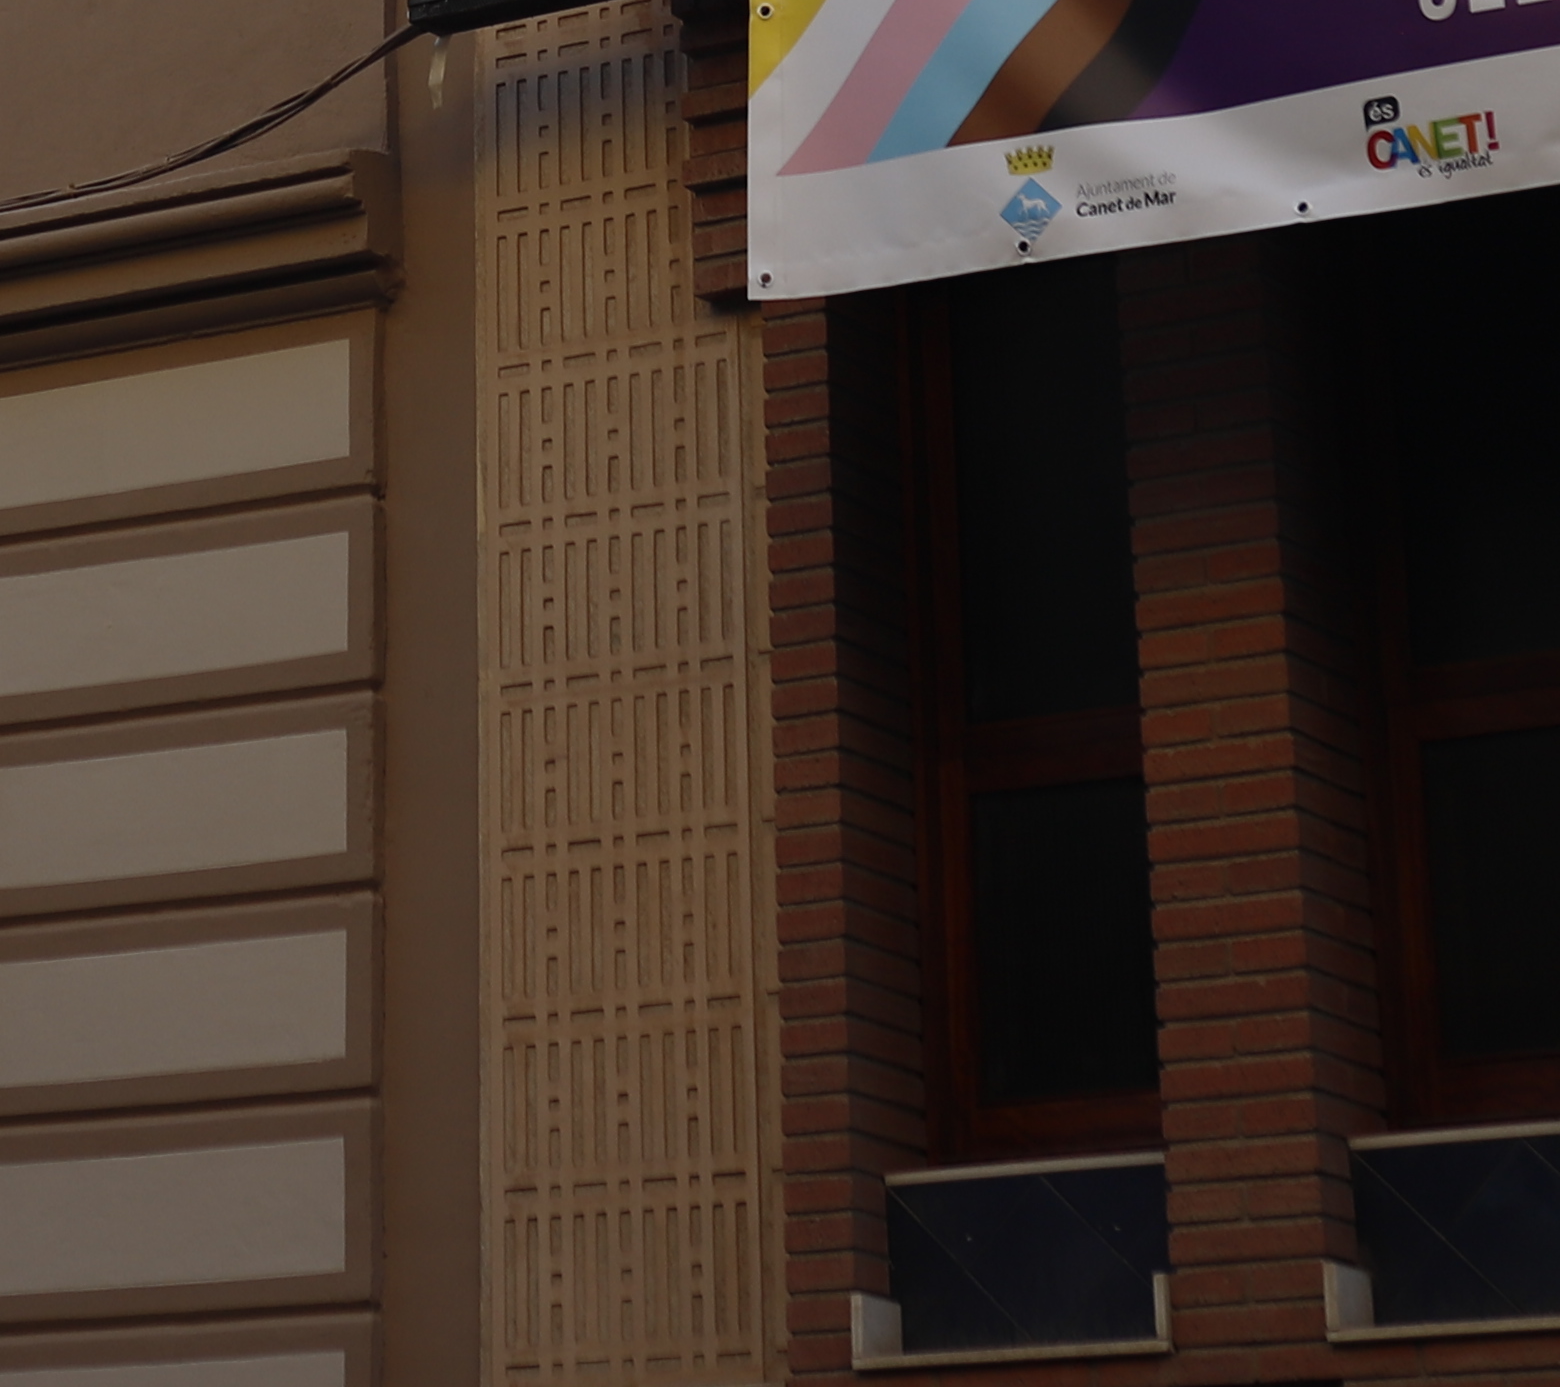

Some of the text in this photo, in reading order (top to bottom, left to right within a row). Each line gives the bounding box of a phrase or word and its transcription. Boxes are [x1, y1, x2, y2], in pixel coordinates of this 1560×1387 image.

[1368, 101, 1395, 122] és
[1366, 110, 1500, 170] CANET!
[1438, 151, 1493, 179] igualtat
[1076, 170, 1176, 199] Ajuntament de
[1076, 189, 1176, 217] Canet de Mar
